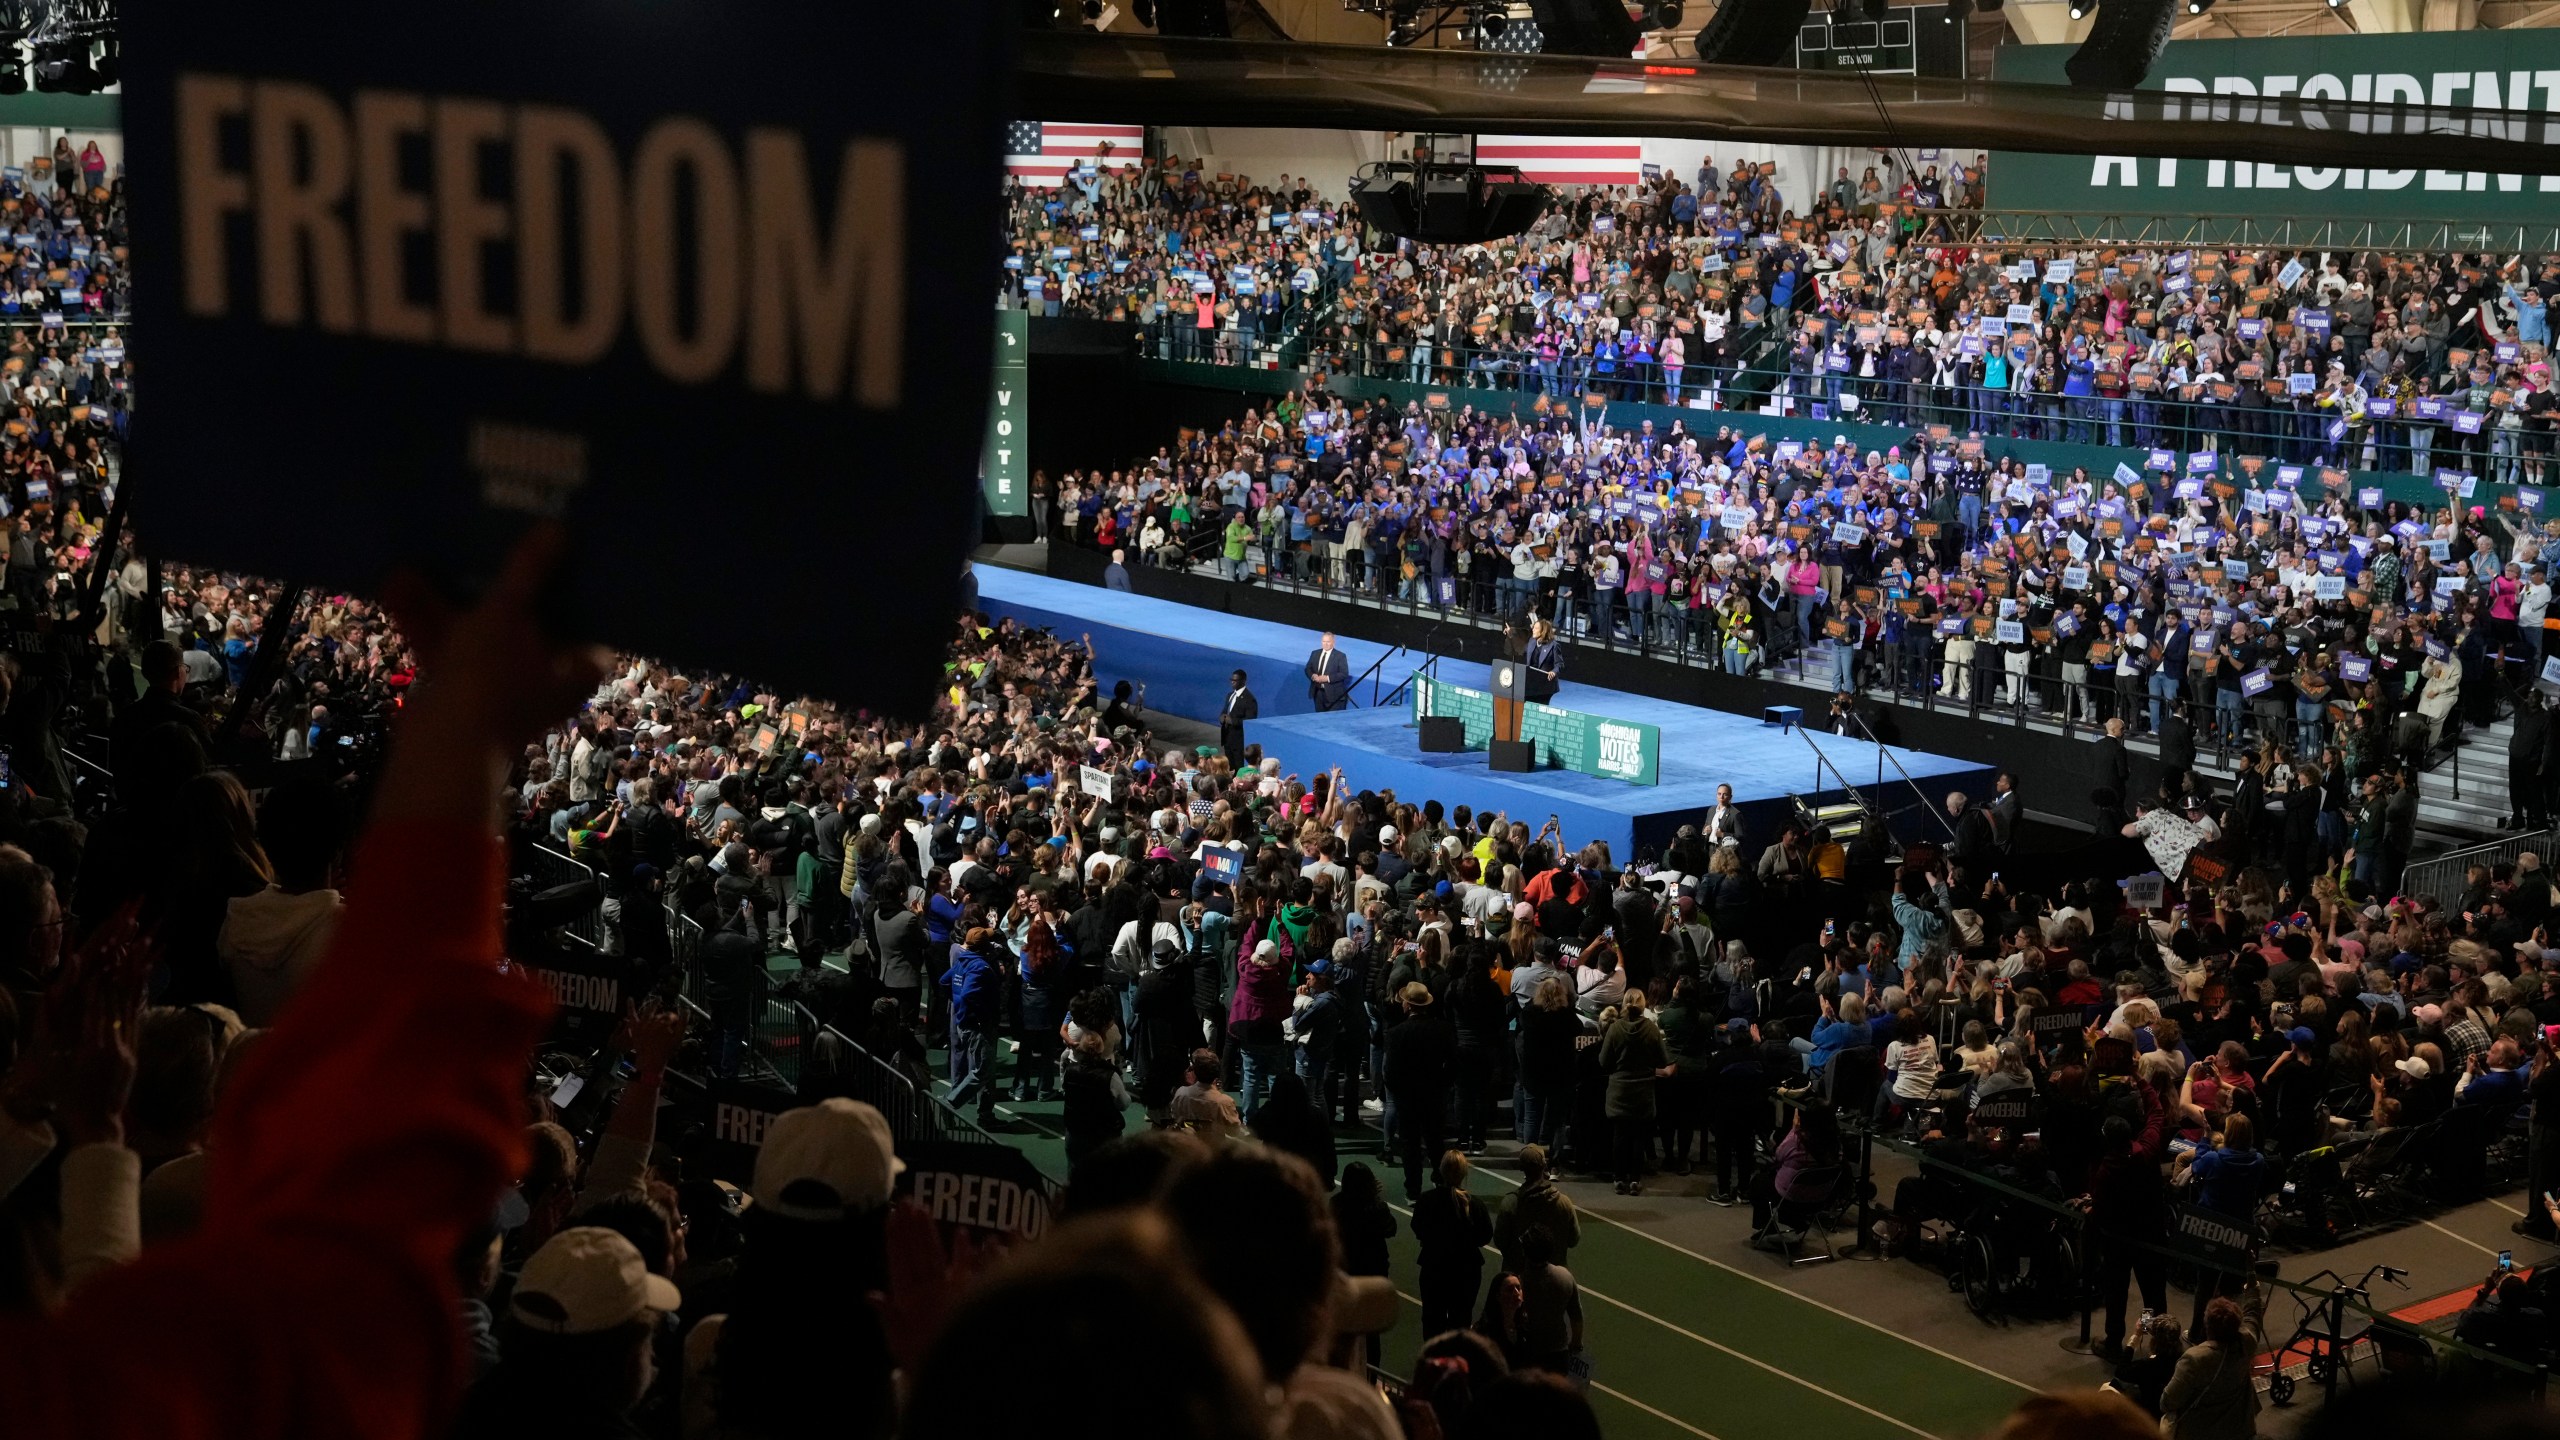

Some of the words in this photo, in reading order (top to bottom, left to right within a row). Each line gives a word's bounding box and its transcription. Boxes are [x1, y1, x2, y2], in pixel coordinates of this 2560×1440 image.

[1838, 55, 1854, 65] SETS
[1857, 54, 1872, 64] WON
[174, 70, 909, 412] FREEDOM
[2241, 323, 2260, 331] HARRIS
[2498, 347, 2515, 355] HARRIS
[1829, 356, 1846, 364] HARRIS
[2370, 402, 2390, 410] HARRIS
[2420, 402, 2441, 410] HARRIS
[2458, 415, 2478, 425] HARRIS
[2152, 454, 2168, 462] HARRIS
[2192, 455, 2212, 464] HARRIS
[1932, 460, 1952, 468] HARRIS
[2280, 470, 2298, 479] HARRIS
[2439, 472, 2462, 483] HARRIS
[2178, 482, 2198, 491] HARRIS
[2267, 493, 2287, 504] HARRIS
[2362, 493, 2378, 501] HARRIS
[2521, 492, 2539, 503] HARRIS
[1614, 502, 1632, 510] HARRIS
[2058, 500, 2076, 510] HARRIS
[1640, 509, 1658, 520] HARRIS
[2302, 519, 2322, 529] HARRIS
[2320, 554, 2337, 563] HARRIS
[1878, 576, 1899, 585] HARRIS
[2119, 568, 2137, 582] HARRIS
[2169, 583, 2190, 592] HARRIS
[2182, 607, 2200, 616] HARRIS
[2213, 610, 2232, 621] HARRIS
[2426, 639, 2444, 655] HARRIS
[2345, 661, 2366, 672] HARRIS
[2245, 673, 2266, 688] HARRIS
[1600, 723, 1640, 742] MICHIGAN
[1600, 737, 1640, 764] VOTES
[1598, 758, 1638, 775] HARRIS-WALZ
[1205, 852, 1238, 876] KAMALA
[2191, 854, 2226, 878] HARRIS
[2192, 867, 2216, 883] WALZ
[2034, 1012, 2082, 1030] FREEDOM
[913, 1171, 1048, 1241] FREEDO
[2180, 1214, 2248, 1250] FREEDOM
